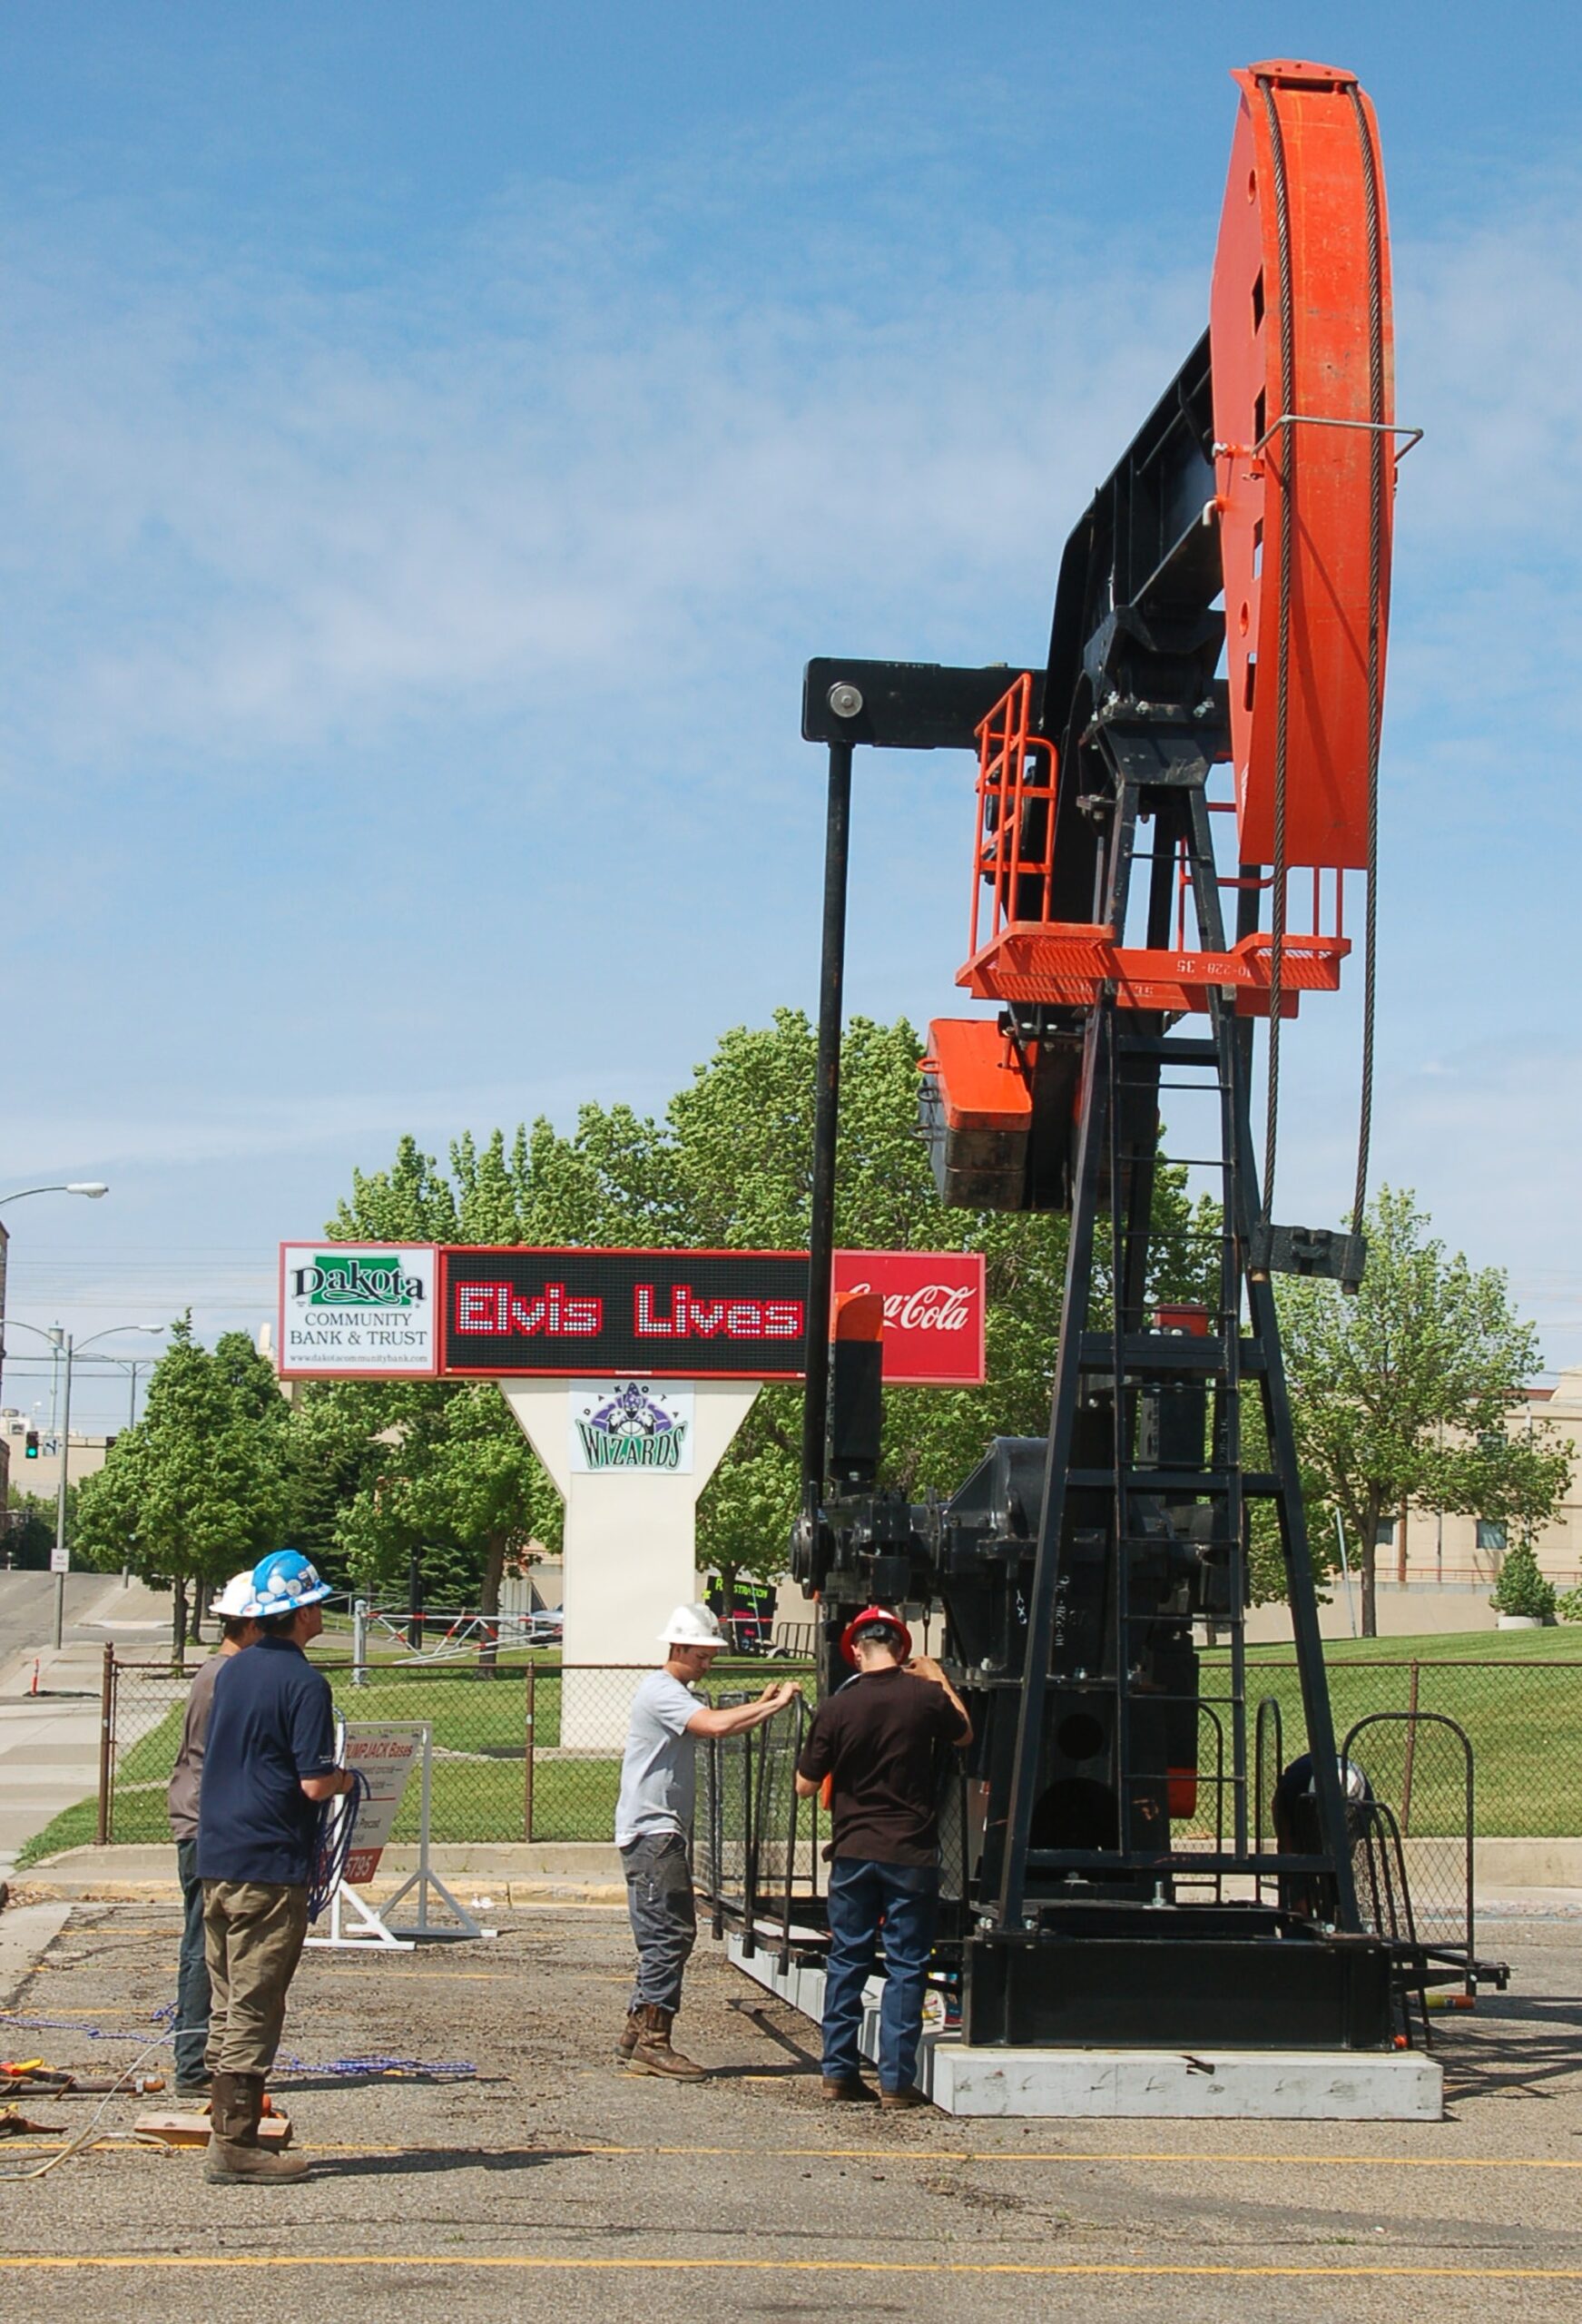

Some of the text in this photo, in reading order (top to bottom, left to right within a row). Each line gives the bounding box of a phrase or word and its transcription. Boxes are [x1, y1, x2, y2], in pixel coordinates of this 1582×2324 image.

[290, 1260, 427, 1305] Dakota
[304, 1312, 413, 1327] COMMUNITY
[457, 1284, 802, 1336] Elvis Lives
[290, 1330, 428, 1346] BANK & TRUST
[290, 1353, 428, 1364] www.dakotacommunitybank.com
[576, 1420, 688, 1469] WIZARDS
